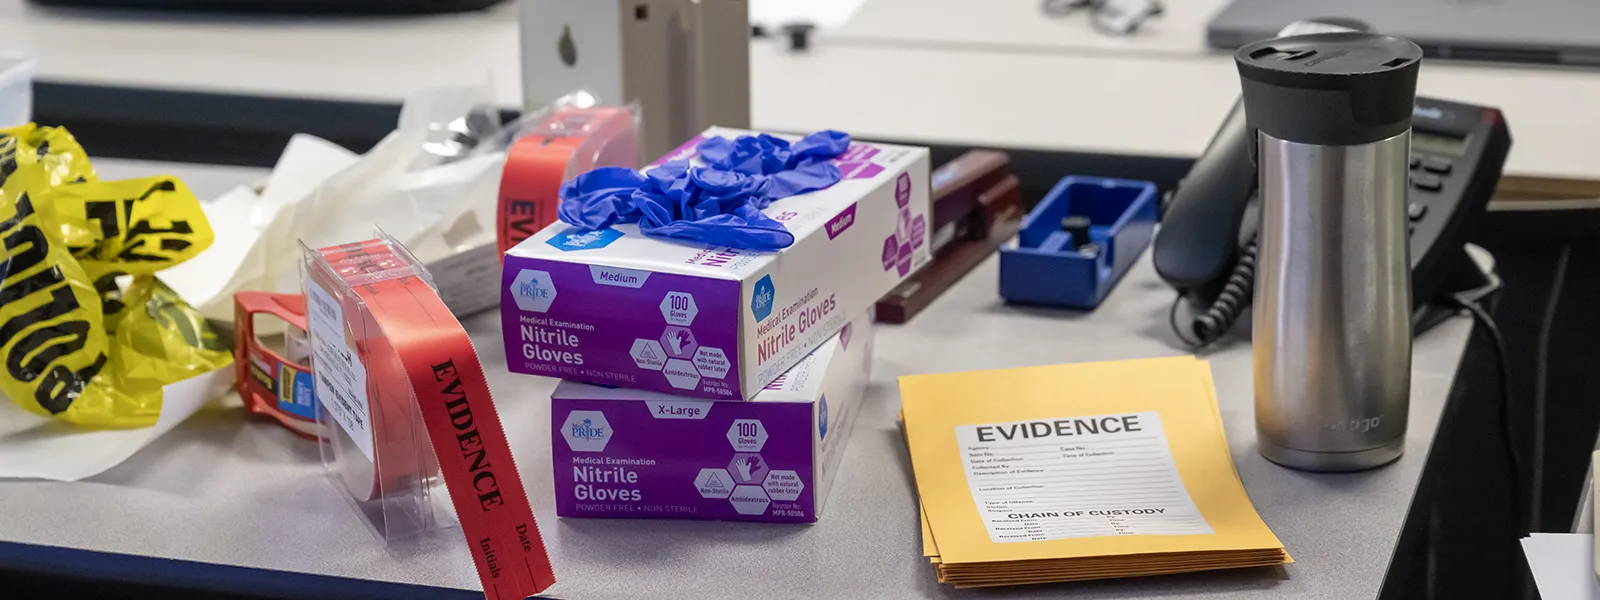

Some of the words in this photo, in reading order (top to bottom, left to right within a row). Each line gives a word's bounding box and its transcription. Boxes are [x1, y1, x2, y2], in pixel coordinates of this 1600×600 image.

[830, 213, 853, 236] Medium
[600, 271, 638, 285] Medium
[669, 295, 689, 311] 100
[669, 310, 688, 319] Gloves
[757, 313, 781, 340] Medical
[782, 287, 819, 321] Examination
[520, 315, 548, 326] Medical
[549, 318, 595, 332] Examination
[758, 323, 796, 366] Nitrile
[798, 292, 836, 334] Gloves
[520, 324, 579, 347] Nitrile
[522, 343, 584, 365] Gloves
[525, 362, 557, 373] POWDER
[558, 366, 579, 376] FREE
[586, 369, 604, 379] NON
[605, 372, 637, 384] STERILE
[658, 405, 701, 418] X-Large
[430, 358, 504, 512] EVIDENCE
[571, 427, 605, 439] PRIDE
[736, 422, 757, 438] 100
[976, 415, 1142, 442] EVIDENCE
[738, 438, 757, 446] Gloves
[573, 456, 605, 466] Medical
[606, 457, 656, 467] Examination
[573, 466, 639, 484] Nitrile
[574, 484, 642, 501] Gloves
[575, 503, 611, 512] POWDER
[613, 504, 635, 512] FREE
[643, 505, 663, 513] NON
[664, 505, 699, 514] STERILE
[1088, 508, 1165, 516] CUSTODY
[515, 523, 532, 553] Date
[479, 537, 502, 580] Initials
